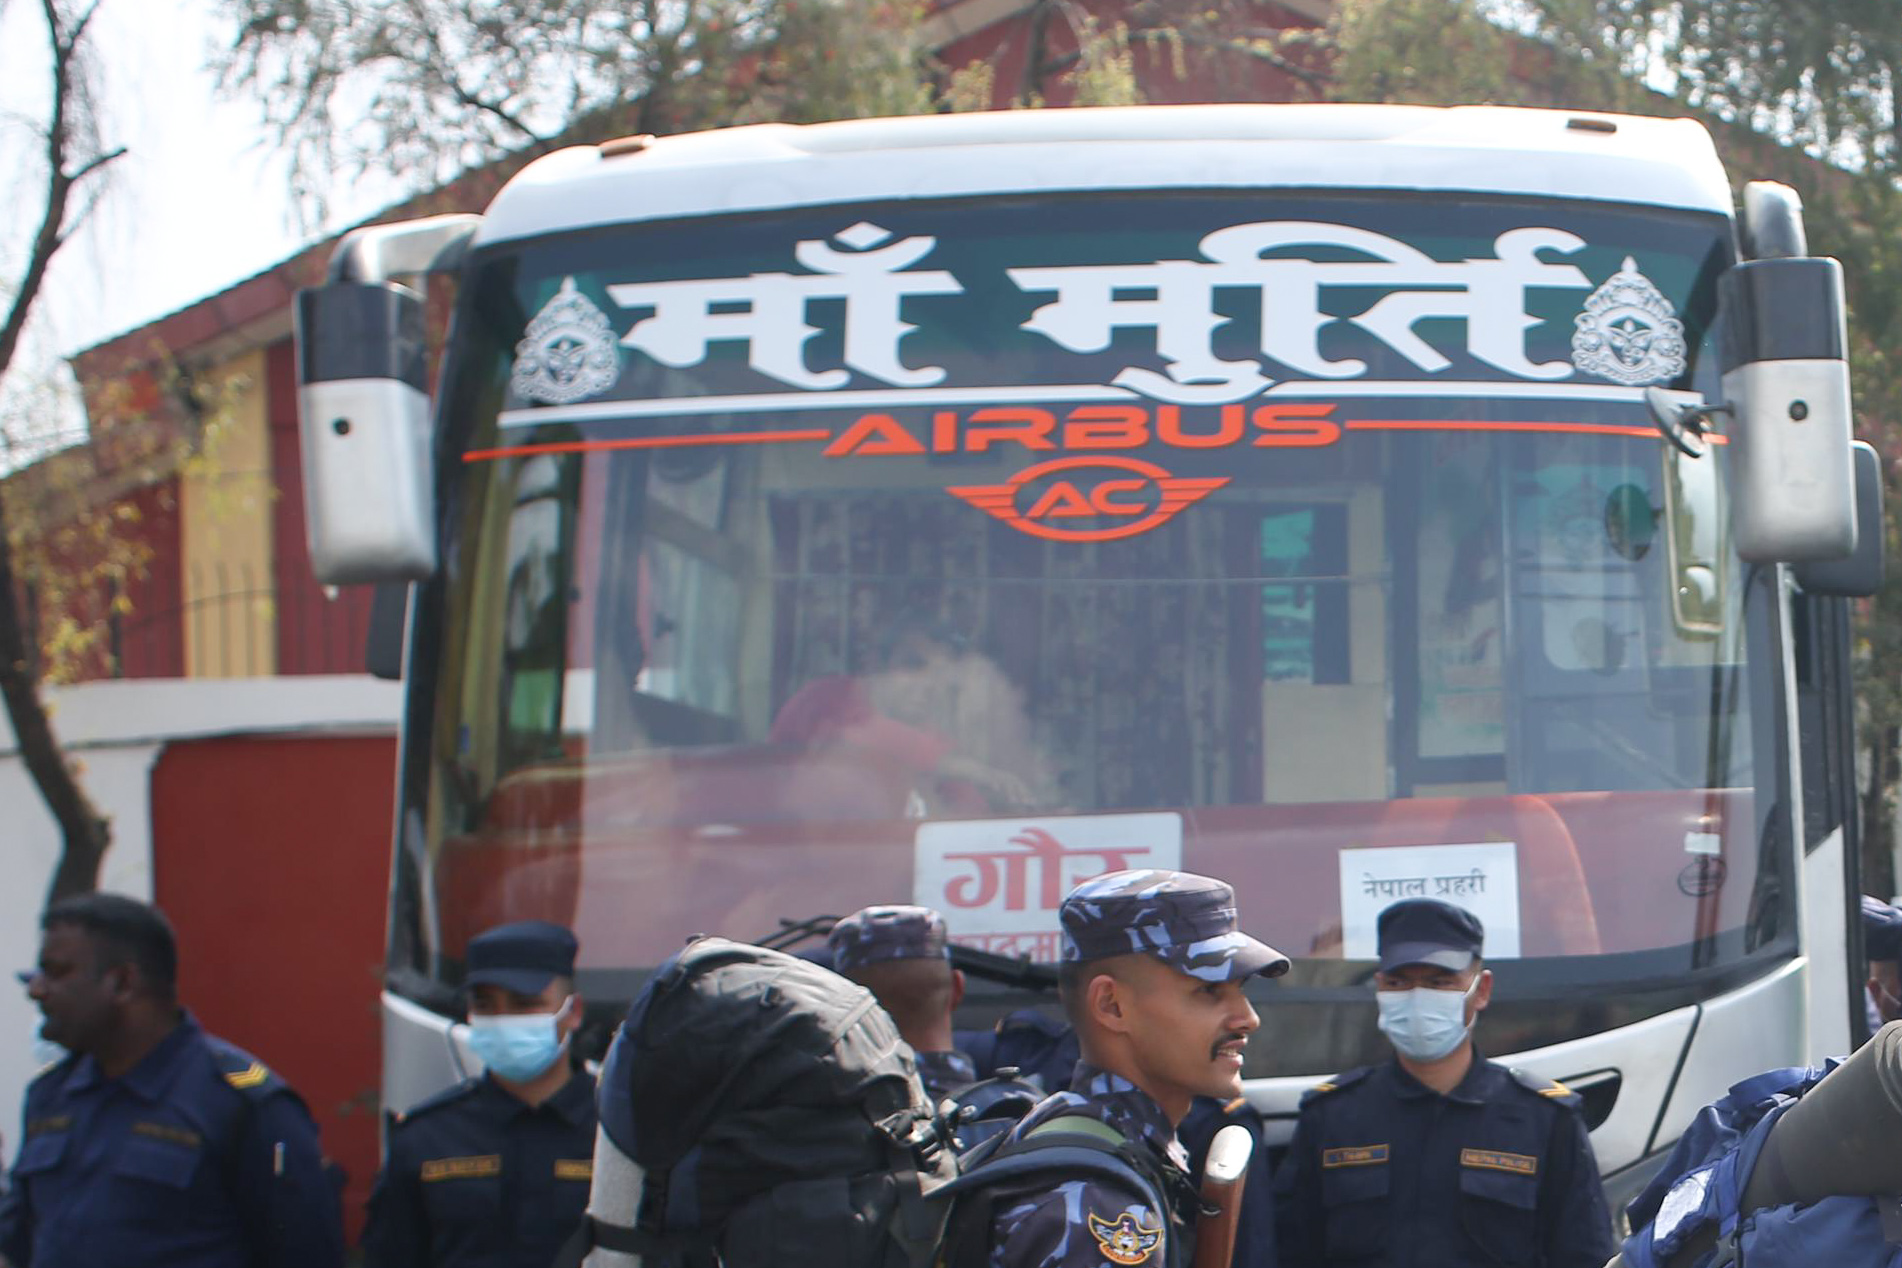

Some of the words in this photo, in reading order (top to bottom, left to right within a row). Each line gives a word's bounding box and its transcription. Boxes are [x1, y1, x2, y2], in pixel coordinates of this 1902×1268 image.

[605, 220, 966, 391] माँ
[821, 403, 1341, 456] AIRBUS
[1026, 477, 1150, 518] AC
[1362, 872, 1427, 898] नेपाल
[1434, 867, 1488, 897] प्रहरी
